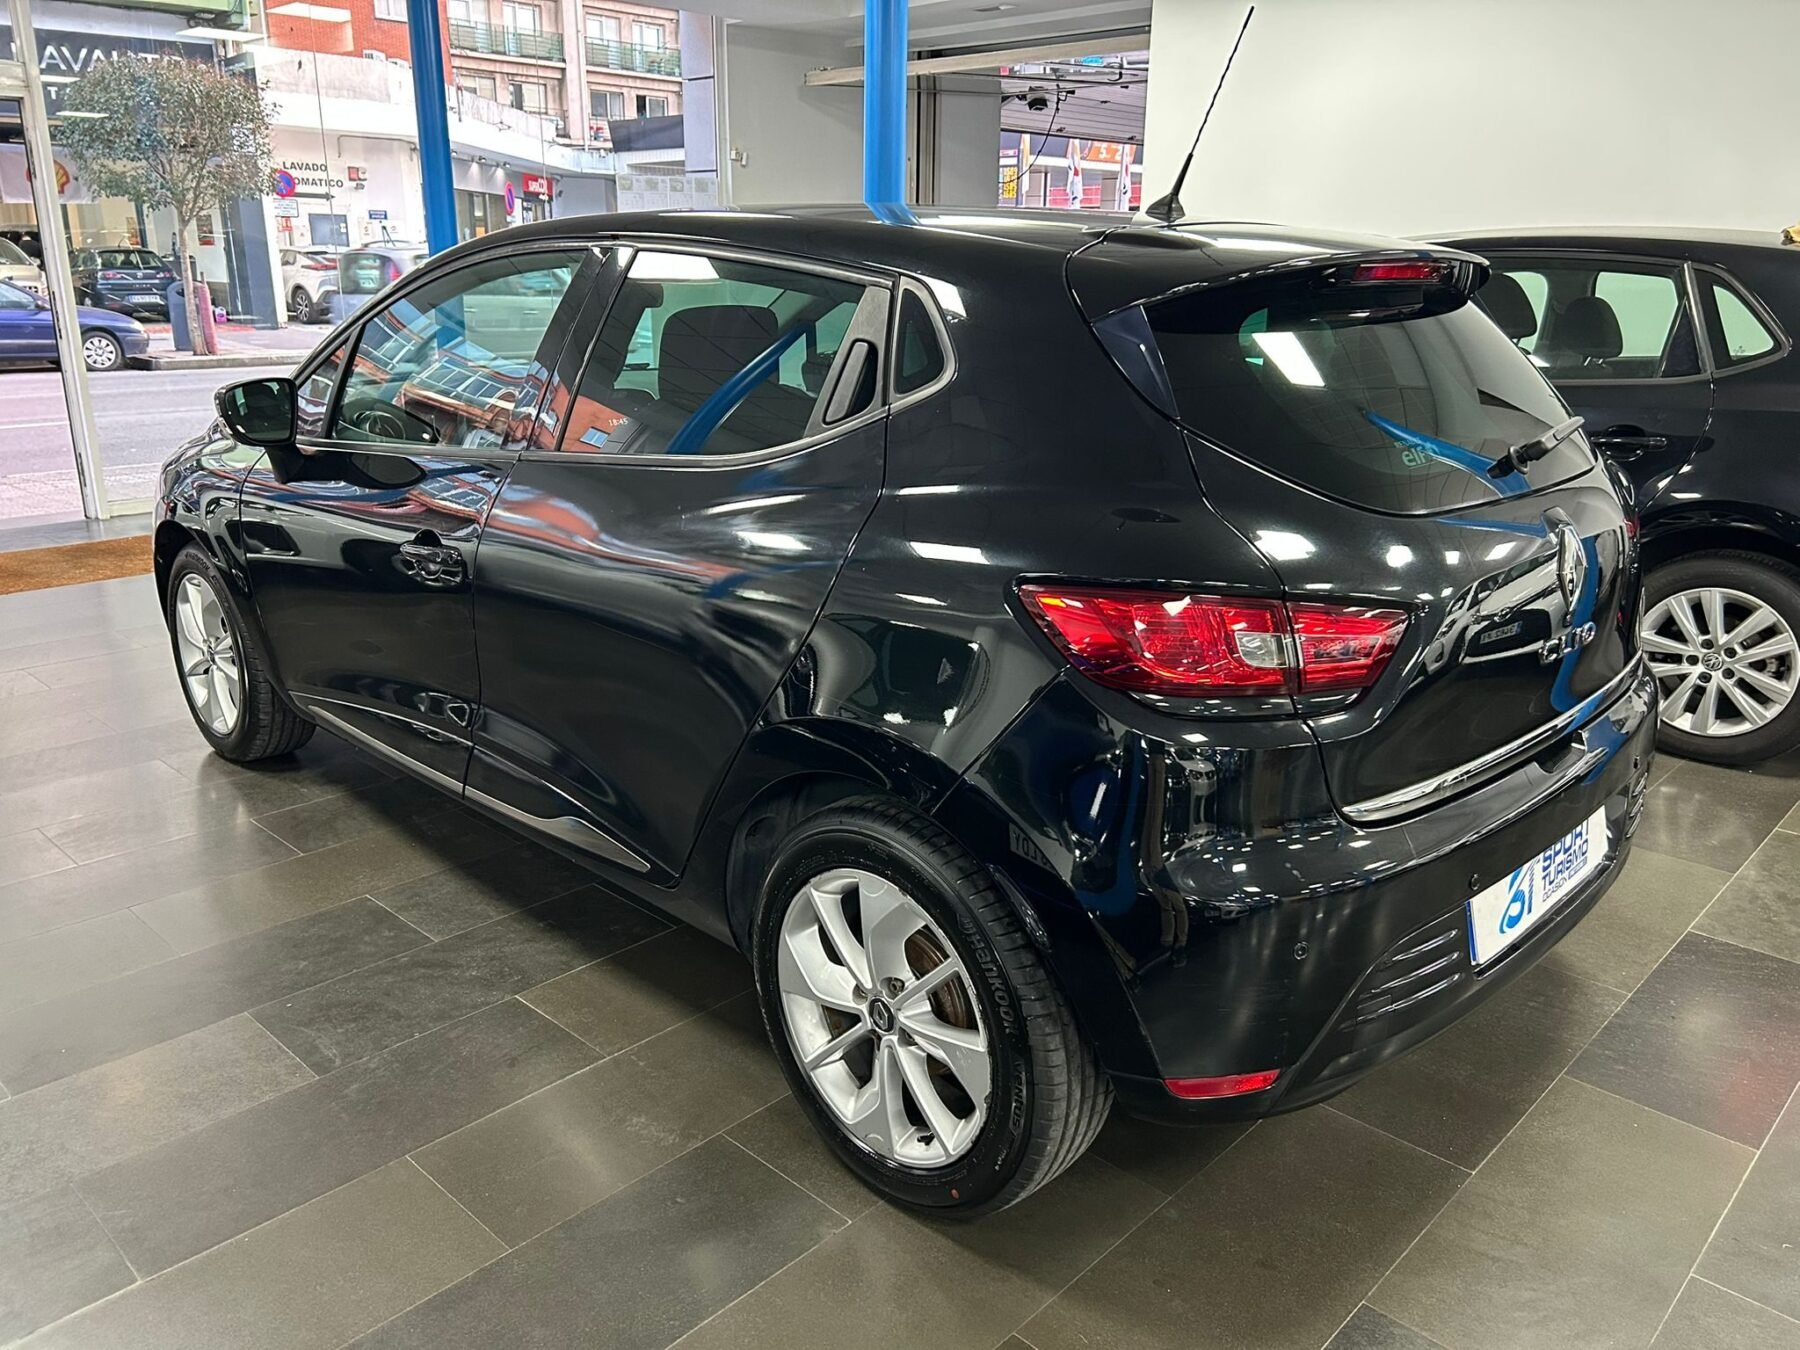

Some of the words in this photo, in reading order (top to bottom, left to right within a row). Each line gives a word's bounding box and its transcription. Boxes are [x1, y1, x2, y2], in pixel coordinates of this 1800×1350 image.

[283, 161, 328, 172] LAVADO
[608, 418, 629, 426] 18:45
[1539, 621, 1597, 662] CLIO
[1541, 838, 1589, 891] TURISMO
